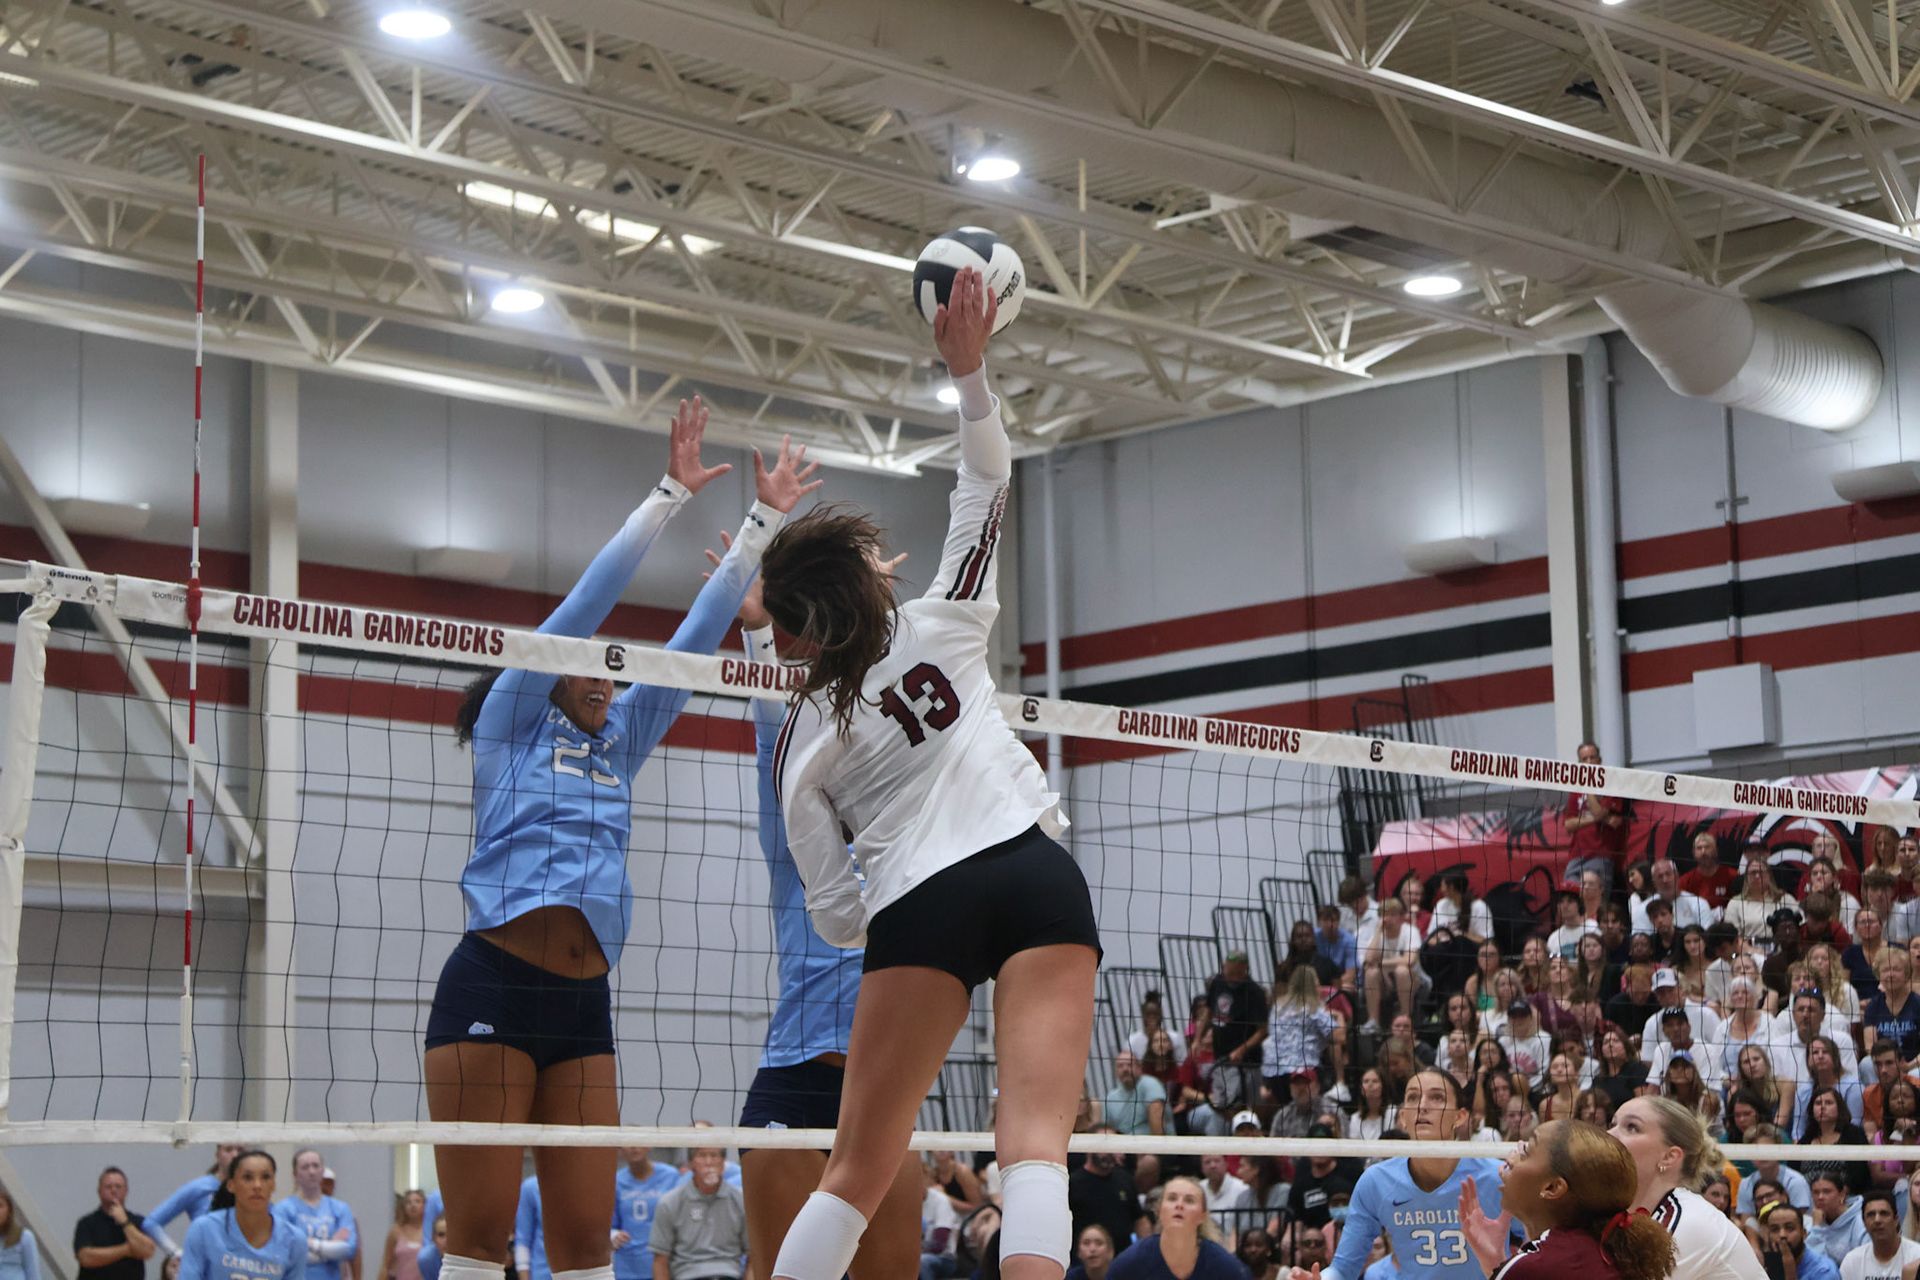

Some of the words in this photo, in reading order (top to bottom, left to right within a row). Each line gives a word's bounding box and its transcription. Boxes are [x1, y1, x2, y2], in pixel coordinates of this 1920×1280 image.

[57, 571, 92, 582] Senoh
[233, 595, 353, 638] CAROLINA
[364, 612, 505, 656] GAMECOCKS
[721, 659, 806, 691] CAROLIN
[879, 662, 961, 748] 13
[1118, 710, 1198, 742] CAROLINA
[1205, 720, 1301, 753] GAMECOCKS
[1450, 749, 1518, 779] CAROLINA
[1525, 758, 1606, 788] GAMECOCKS
[1734, 782, 1794, 809] CAROLINA
[1797, 790, 1868, 816] GAMECOCKS
[1410, 1229, 1469, 1267] 33
